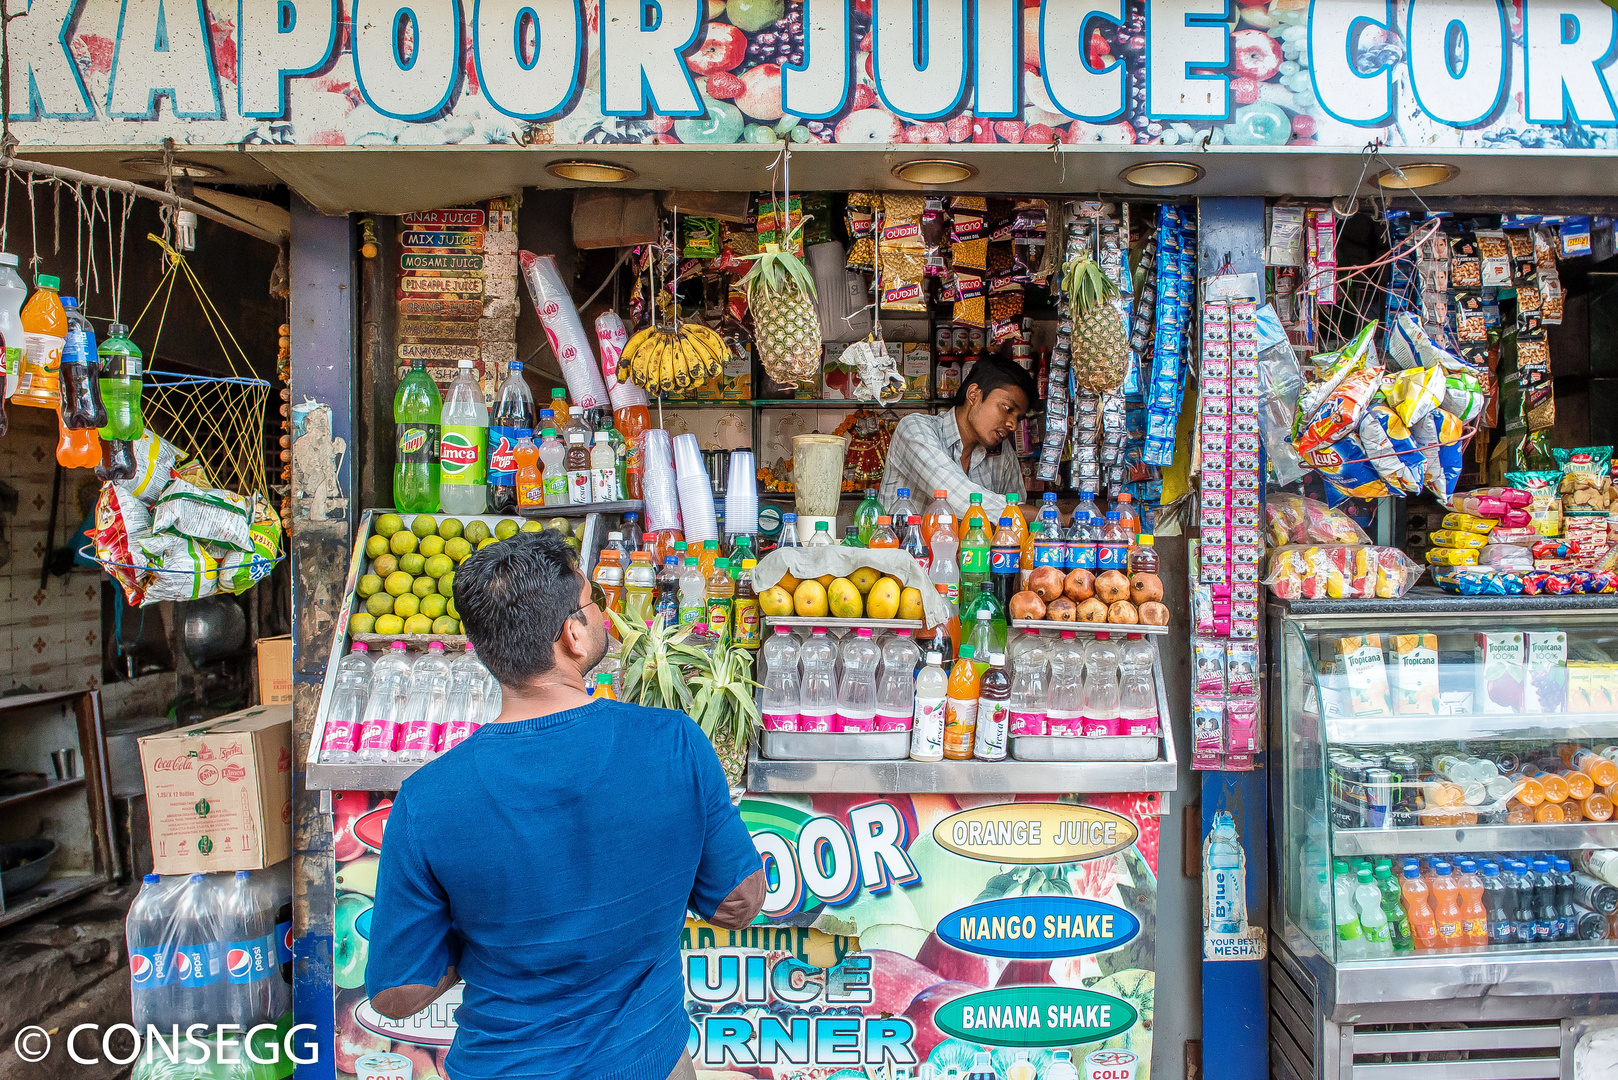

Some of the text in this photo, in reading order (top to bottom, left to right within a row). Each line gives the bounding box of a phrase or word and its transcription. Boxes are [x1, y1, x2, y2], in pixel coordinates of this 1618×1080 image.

[2, 0, 708, 123] KAPOOR
[781, 0, 1232, 124] JUICE
[405, 212, 438, 223] ANAR
[441, 213, 478, 223] JUICE
[408, 234, 477, 246] MIX JUICE
[405, 257, 447, 267] MOSAMI
[405, 280, 480, 292] PINEAPPLE JUICE
[402, 346, 443, 357] BANANA
[493, 455, 515, 463] Thum
[1313, 449, 1339, 466] Lay's
[1488, 643, 1519, 652] Tropicana
[1532, 642, 1562, 652] Tropicana
[1348, 654, 1381, 667] Tropicana
[1402, 656, 1435, 667] Tropicana
[952, 820, 1117, 846] ORANGE JUICE
[959, 914, 1114, 941] MANGO SHAKE
[1214, 946, 1261, 956] MESHA!
[152, 952, 165, 979] pepsi
[192, 952, 204, 979] pepsi
[252, 946, 264, 973] pepsi
[687, 954, 873, 1003] UICE
[378, 1003, 459, 1028] APLE
[962, 1005, 1112, 1030] BANANA SHAKE
[690, 1017, 917, 1065] RNER
[1092, 1070, 1130, 1080] COLD
